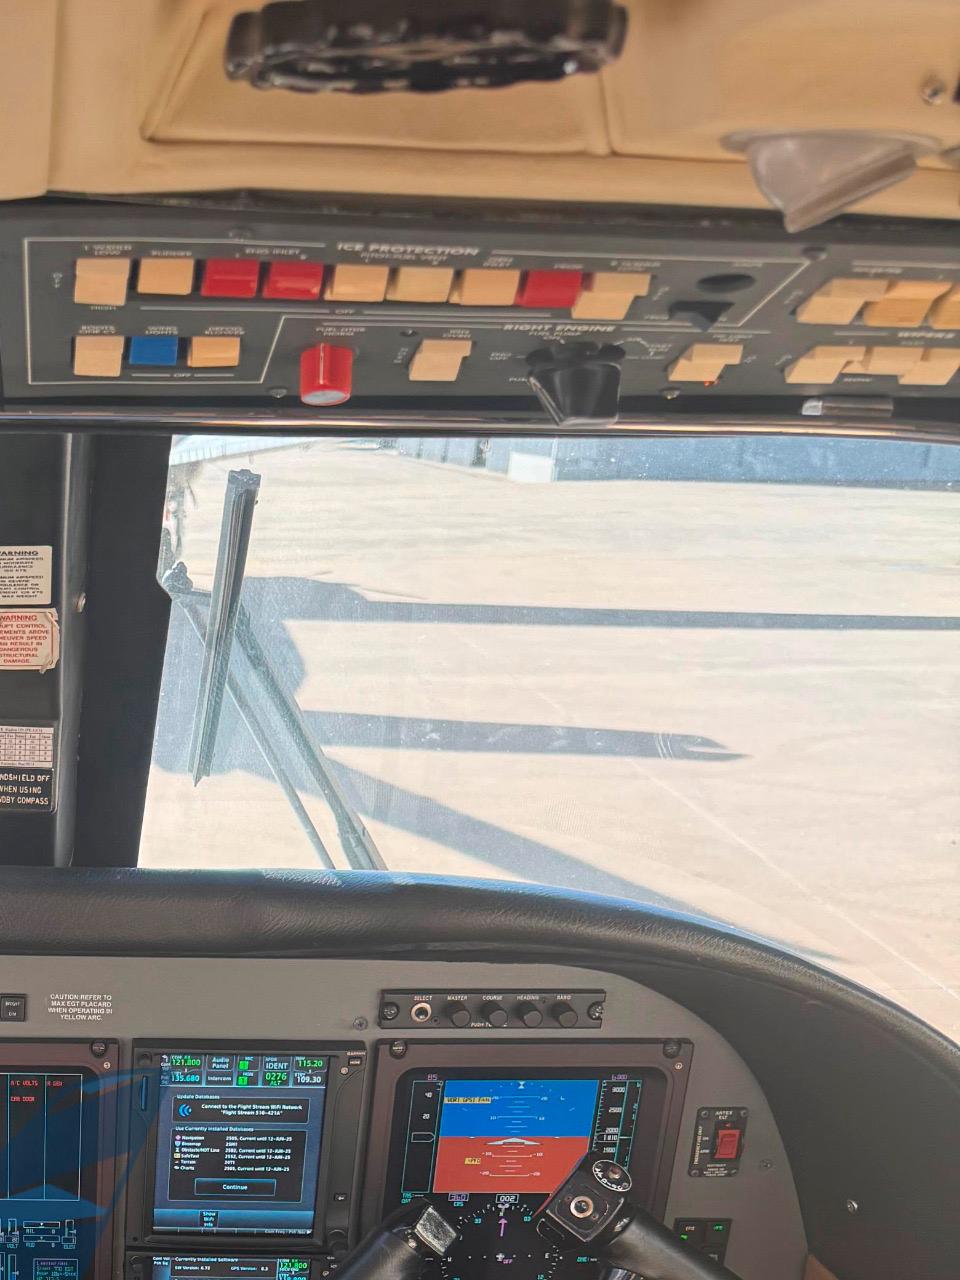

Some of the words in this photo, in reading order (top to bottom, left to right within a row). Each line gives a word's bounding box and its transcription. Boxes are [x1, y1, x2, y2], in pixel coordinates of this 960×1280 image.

[338, 242, 364, 251] ICE
[369, 244, 479, 256] PROTECTION
[503, 324, 552, 332] RIGHT
[18, 797, 49, 805] COMPASS
